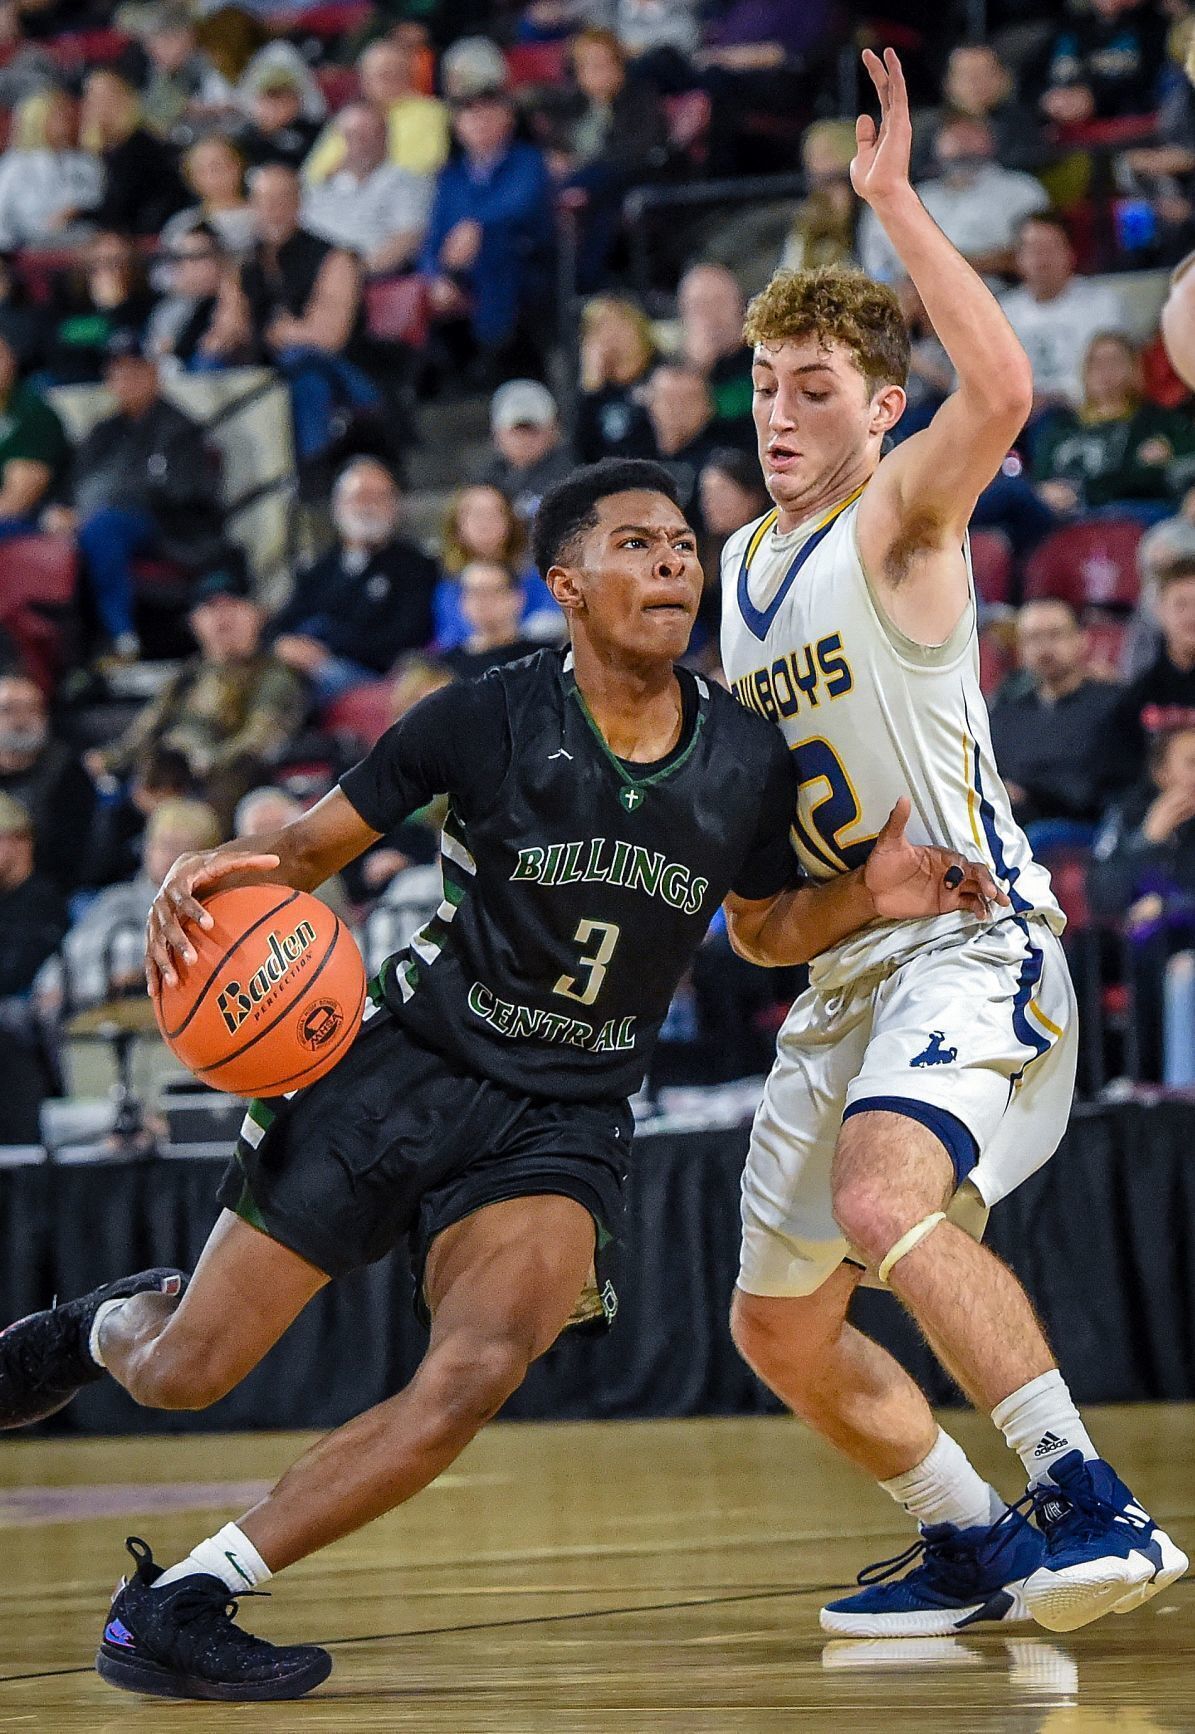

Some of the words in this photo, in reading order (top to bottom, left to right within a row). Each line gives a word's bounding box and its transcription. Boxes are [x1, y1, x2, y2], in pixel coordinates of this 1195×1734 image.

[509, 838, 709, 915] BILLINGS
[217, 919, 317, 1037] Baden
[552, 918, 620, 1005] 3
[467, 981, 637, 1052] CENTRAL
[1034, 1438, 1069, 1457] adidas
